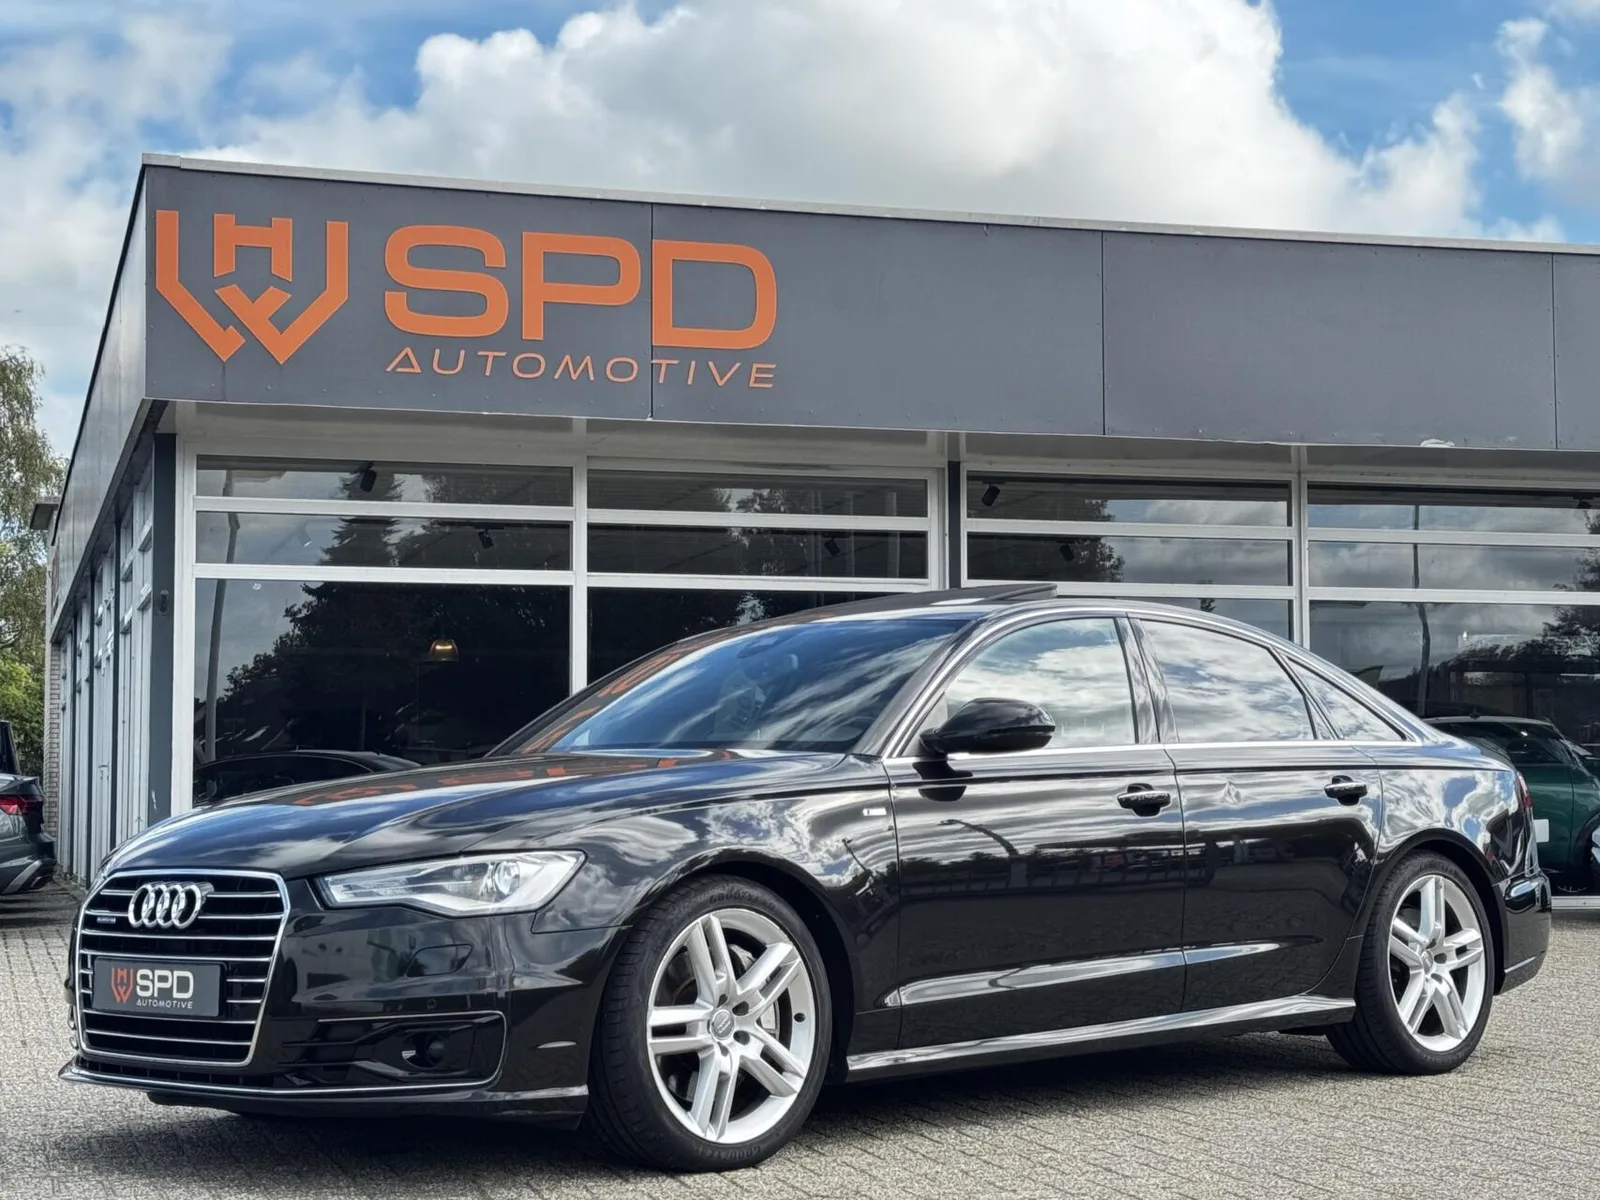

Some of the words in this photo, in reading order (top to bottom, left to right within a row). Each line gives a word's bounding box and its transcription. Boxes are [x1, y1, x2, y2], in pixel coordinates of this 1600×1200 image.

[385, 224, 777, 350] SPD
[386, 346, 778, 390] AUTOMOTIVE
[136, 968, 194, 999] SPD
[136, 999, 193, 1009] AUTOMOTIVE
